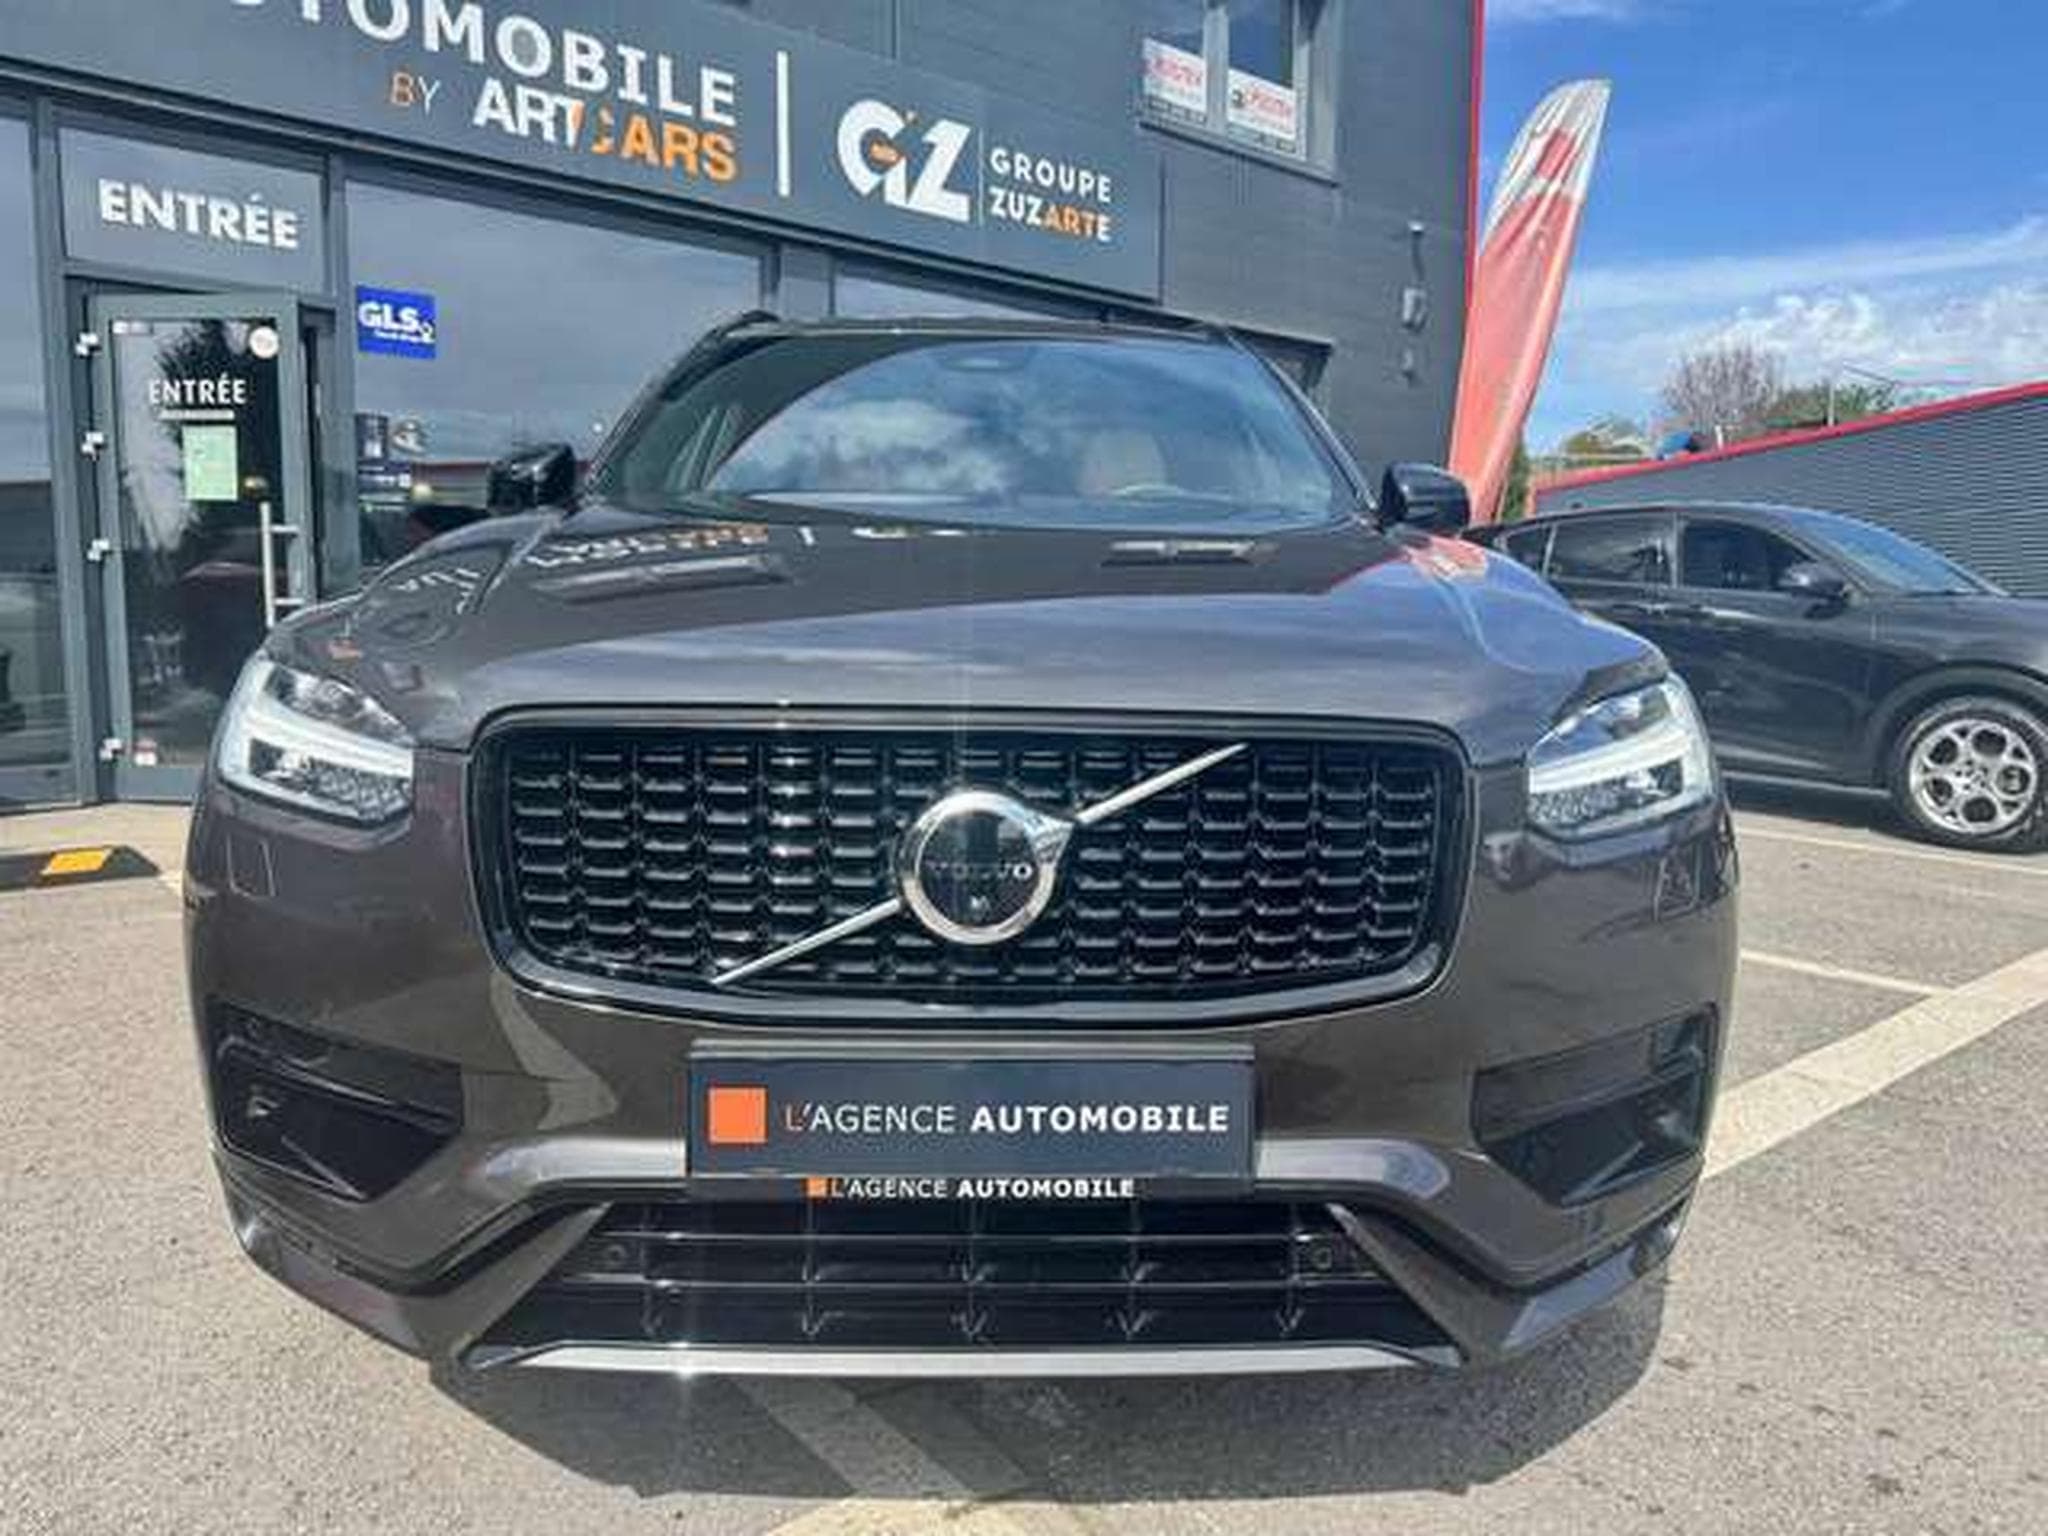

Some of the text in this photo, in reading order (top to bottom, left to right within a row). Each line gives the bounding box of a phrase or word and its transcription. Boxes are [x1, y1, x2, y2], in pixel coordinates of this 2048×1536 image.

[231, 0, 736, 125] OMOBILE
[390, 72, 441, 111] BY
[990, 147, 1111, 202] GROUPE
[99, 178, 298, 248] ENTRÉE
[989, 187, 1111, 241] ZUZARTE
[358, 301, 419, 332] GLS
[149, 372, 246, 405] ENTRÉE
[785, 1105, 1230, 1133] L'AGENCE AUTOMOBILE
[956, 1179, 1136, 1198] AUTOMOBILE
